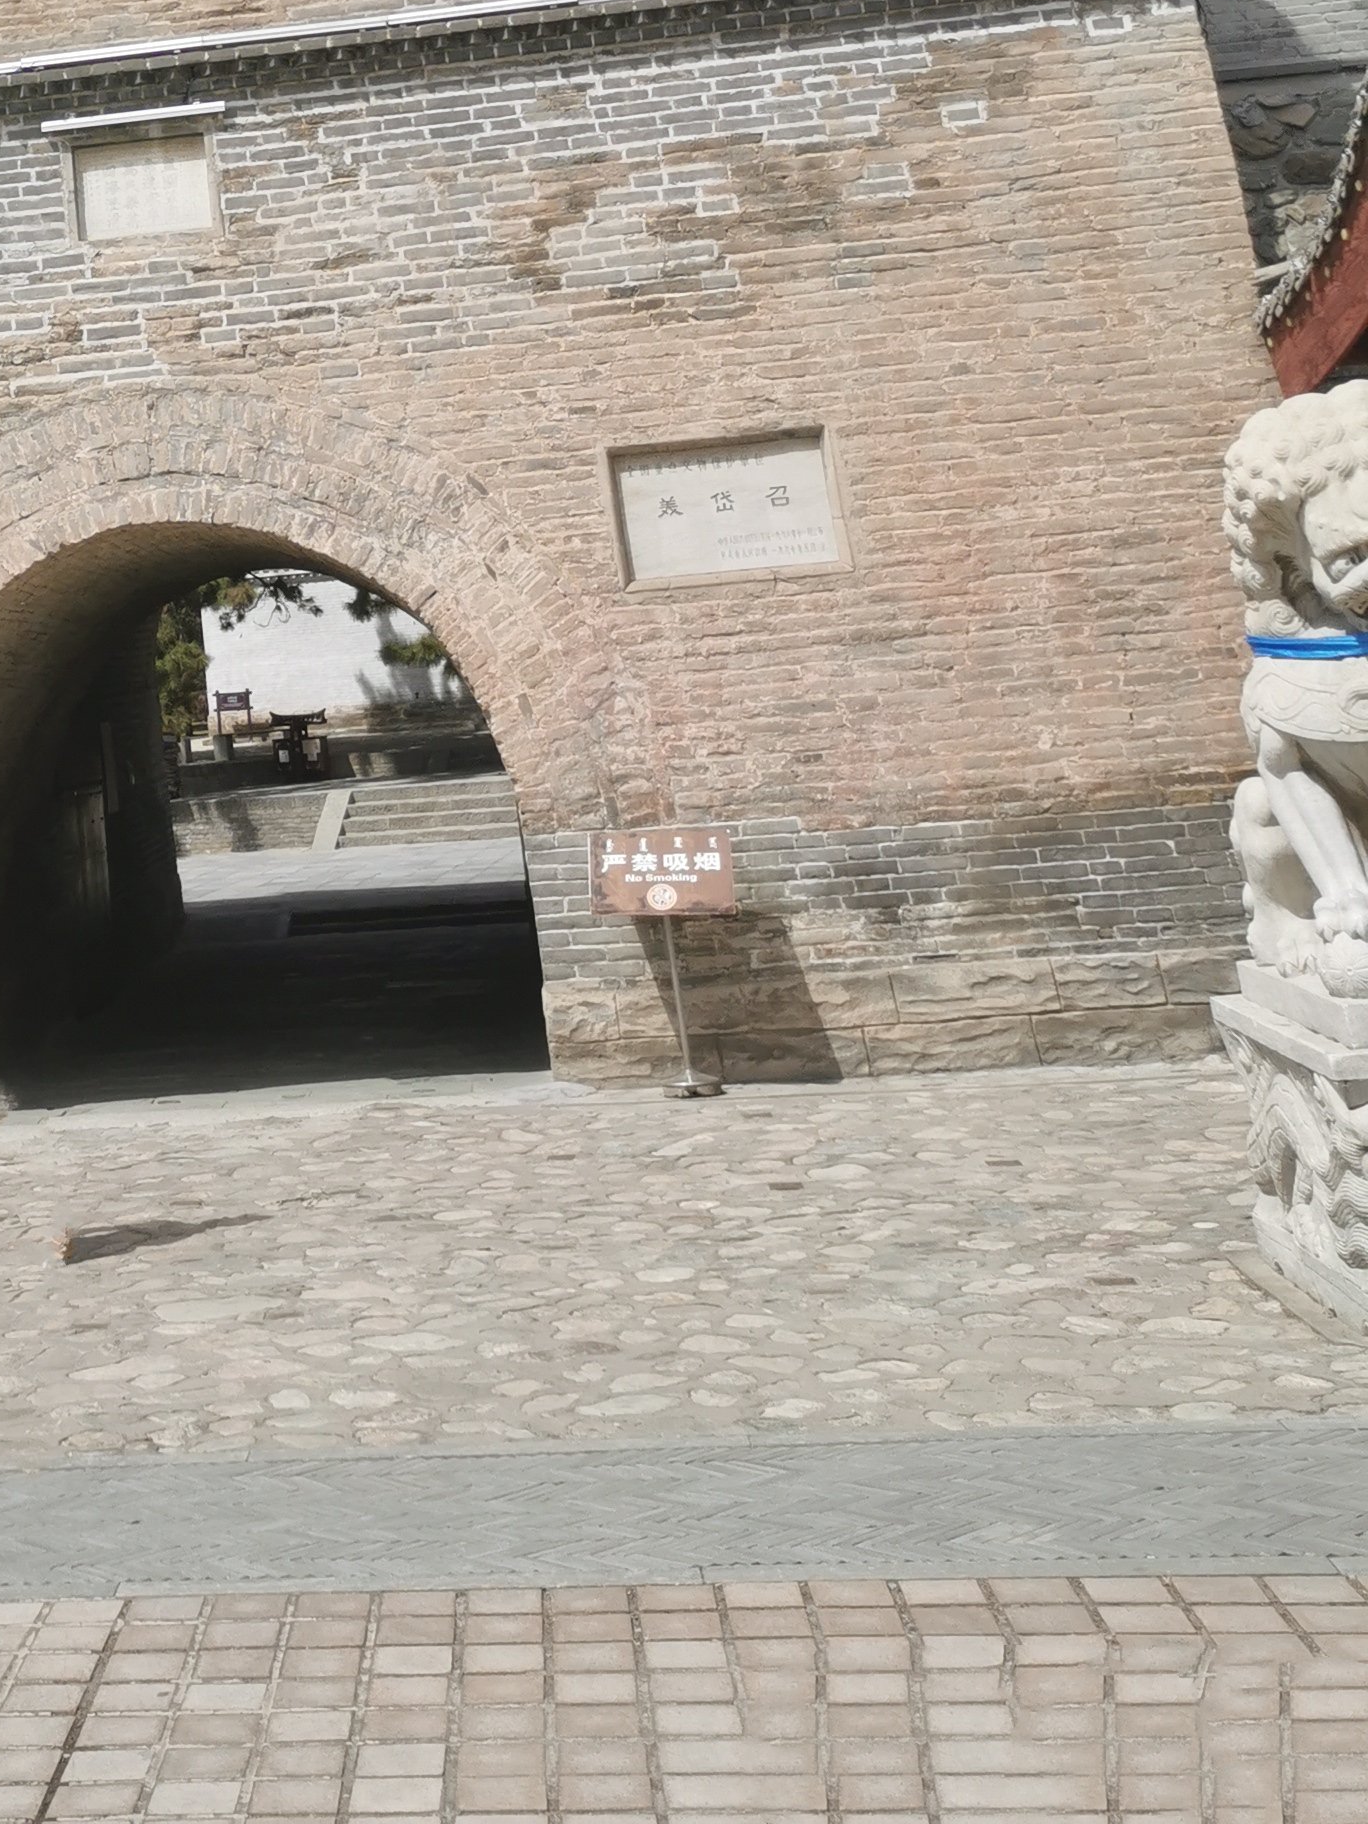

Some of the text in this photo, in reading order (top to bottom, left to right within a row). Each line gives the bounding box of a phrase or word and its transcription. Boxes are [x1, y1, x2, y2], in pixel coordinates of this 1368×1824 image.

[601, 852, 721, 873] 严禁吸烟
[625, 873, 698, 883] No Smoking
